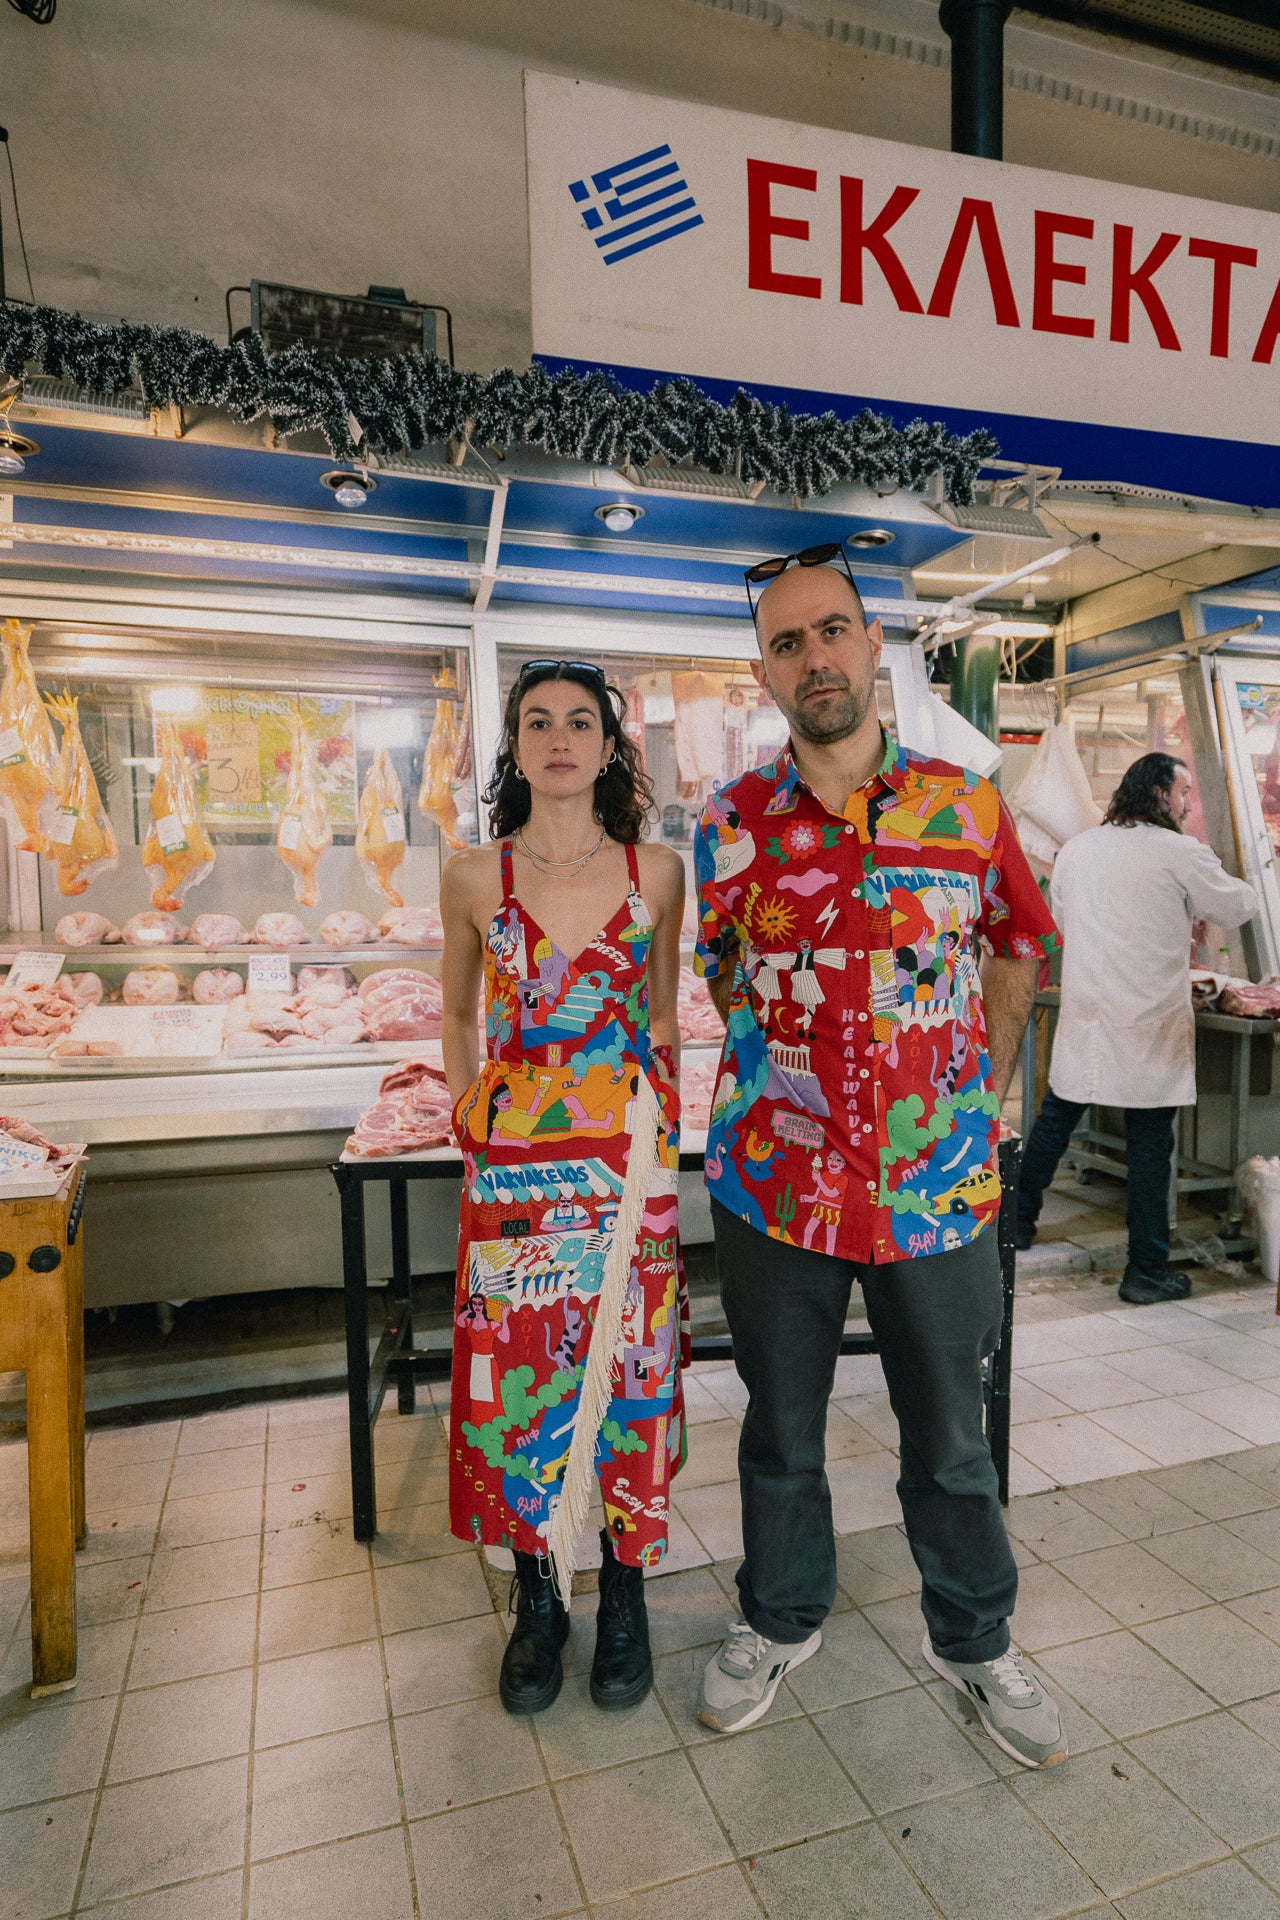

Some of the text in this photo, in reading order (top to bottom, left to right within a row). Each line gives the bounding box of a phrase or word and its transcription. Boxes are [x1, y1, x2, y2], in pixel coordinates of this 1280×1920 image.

[842, 1008, 862, 1147] HEATWAVE
[777, 1124, 822, 1142] MELTING
[784, 1116, 818, 1132] BRAIN
[480, 1165, 590, 1192] VARVAKEIOS
[503, 1220, 530, 1235] LOCAL
